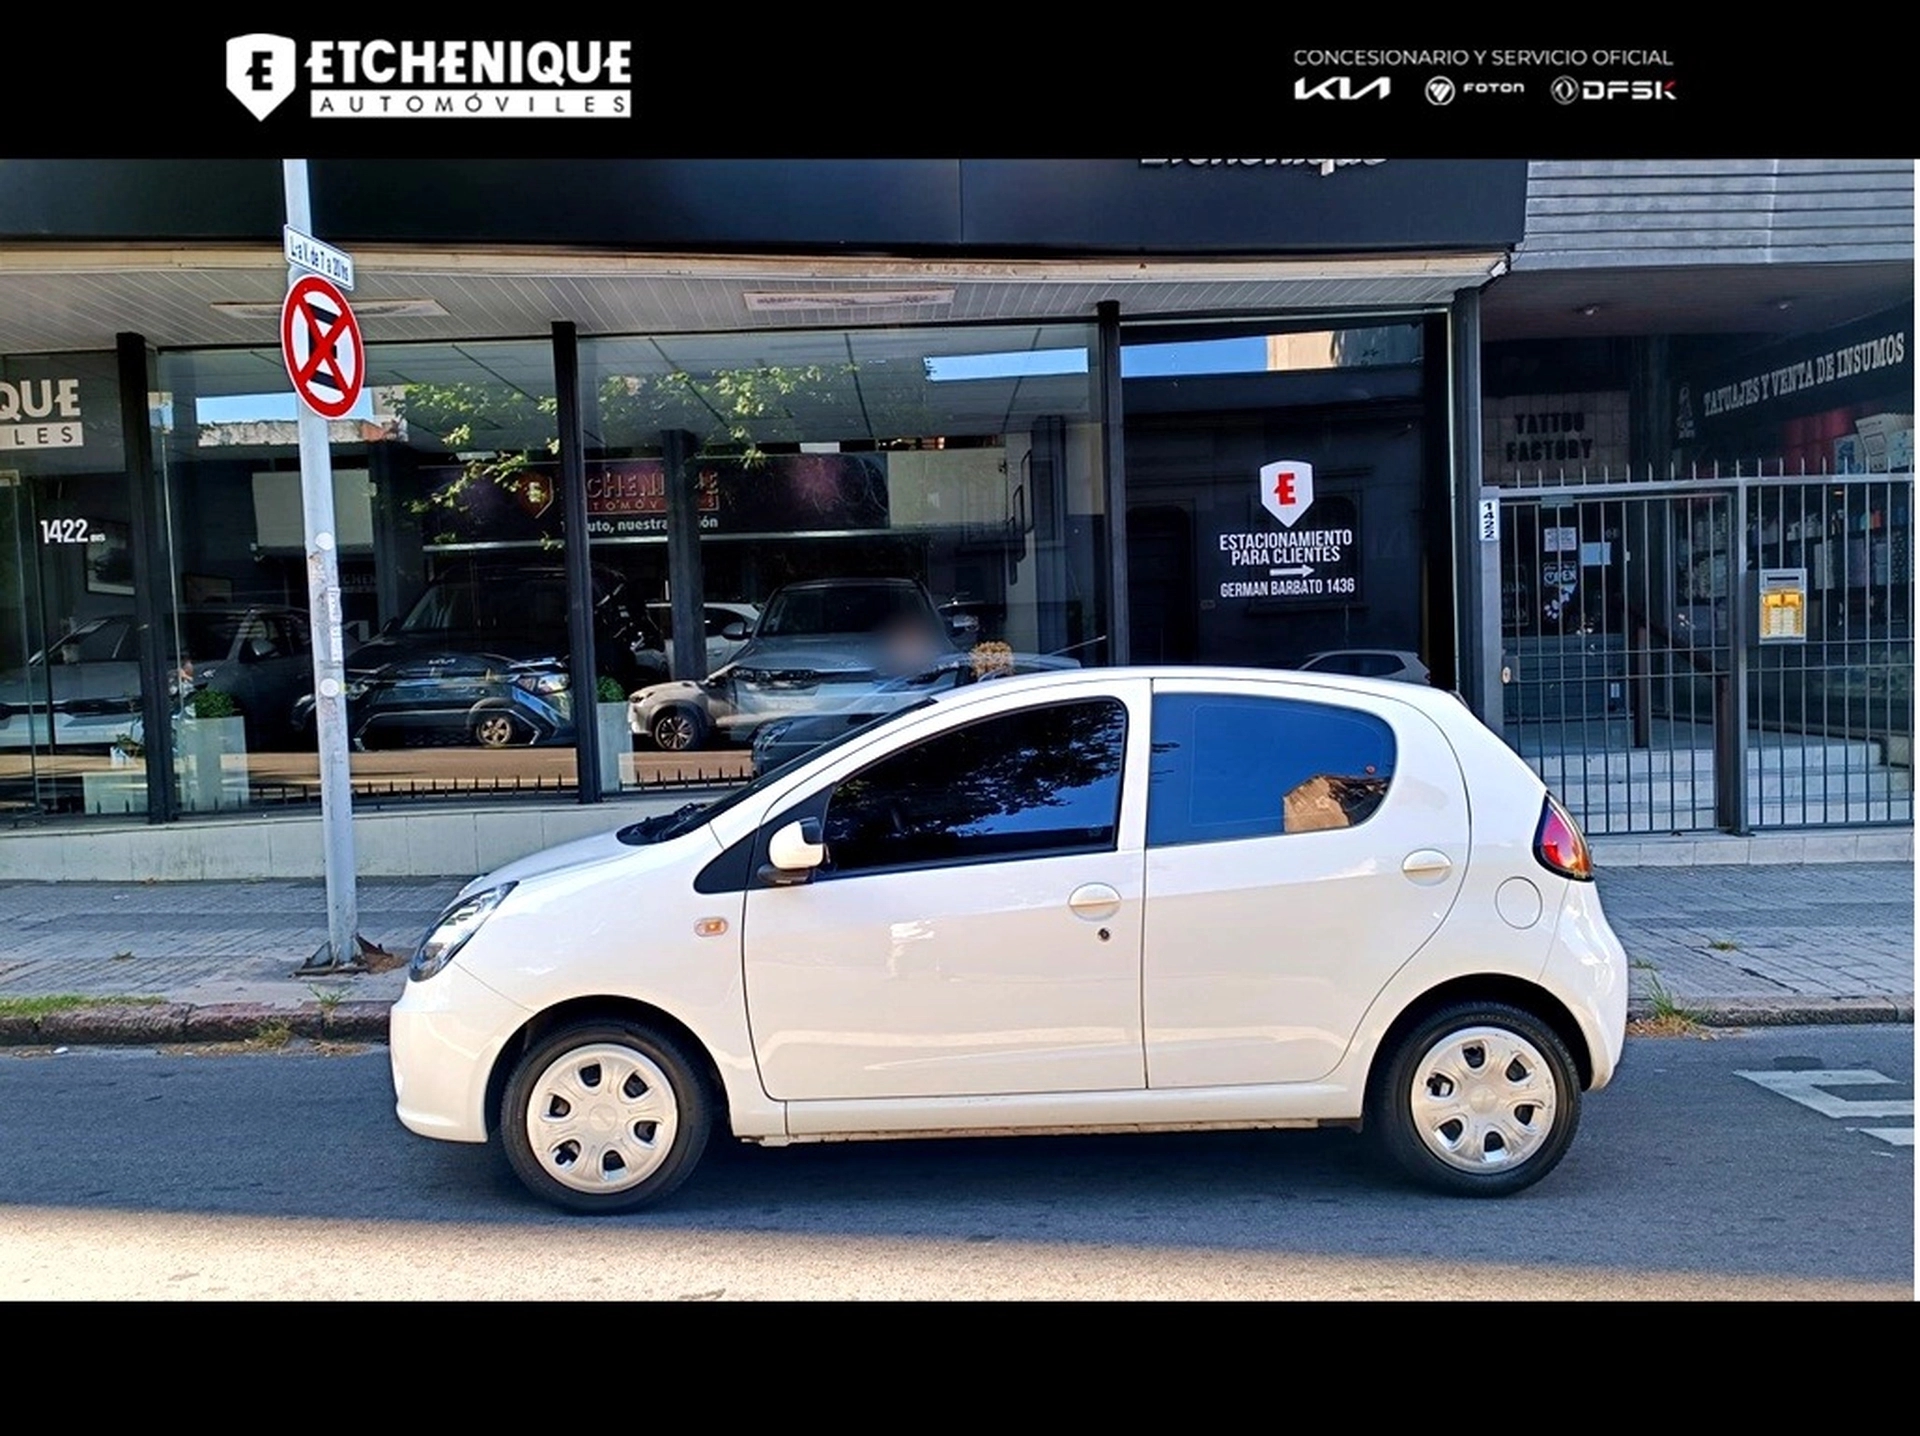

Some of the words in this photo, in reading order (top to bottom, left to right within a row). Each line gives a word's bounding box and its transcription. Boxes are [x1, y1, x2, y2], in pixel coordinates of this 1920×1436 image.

[1704, 374, 1760, 416] TATUAJES
[1760, 372, 1770, 400] Y
[1771, 359, 1815, 397] VENTA
[1817, 352, 1835, 383] DE
[1837, 332, 1904, 378] INSUMOS
[41, 518, 88, 543] 1422
[1219, 529, 1352, 551] ESTACIONAMIENTO
[1231, 548, 1270, 566] PARA
[1273, 545, 1340, 564] CLIENTES
[1220, 581, 1268, 598] GERMAN
[1271, 579, 1323, 595] BARBATO
[1326, 577, 1355, 593] 1436
